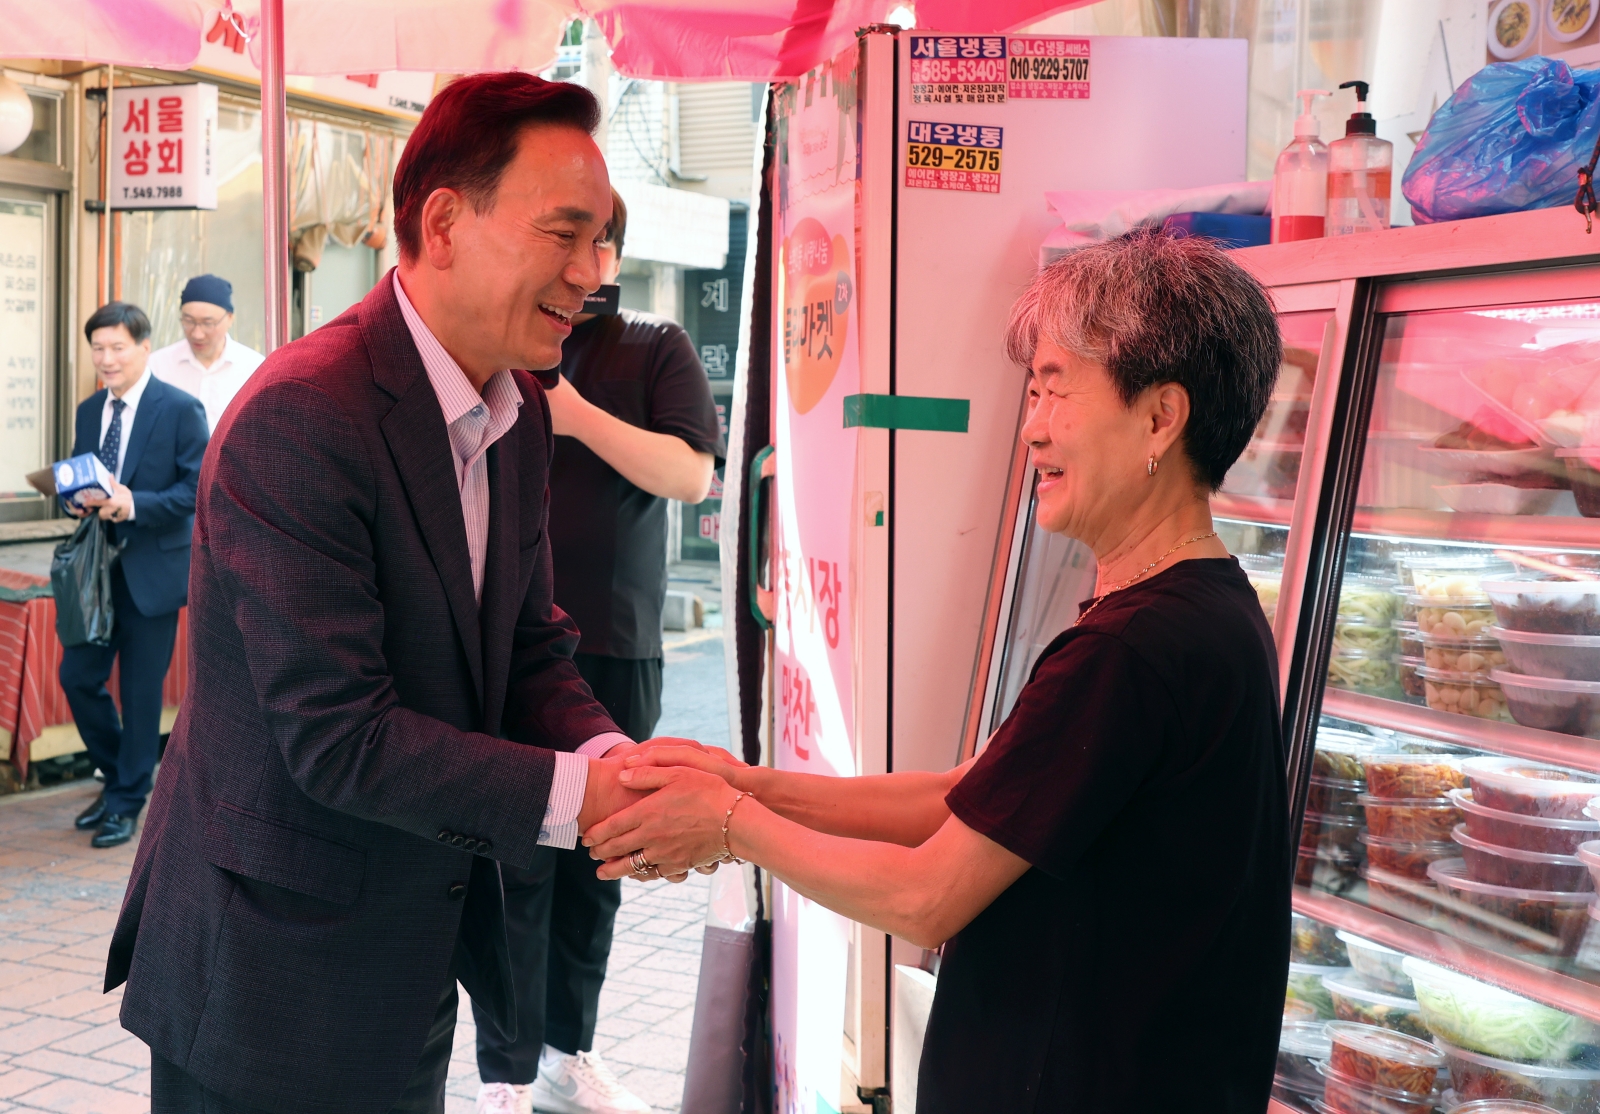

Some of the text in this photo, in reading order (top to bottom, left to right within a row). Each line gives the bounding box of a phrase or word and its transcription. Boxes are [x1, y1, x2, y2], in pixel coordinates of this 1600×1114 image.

[913, 37, 1003, 58] 서울냉동
[921, 60, 997, 82] 585-5340
[123, 97, 183, 134] 서울
[909, 122, 1001, 148] 대우냉동
[123, 138, 183, 176] 상회
[908, 145, 1000, 171] 529-2575
[123, 187, 183, 199] T.549.7988
[701, 278, 730, 378] 계란
